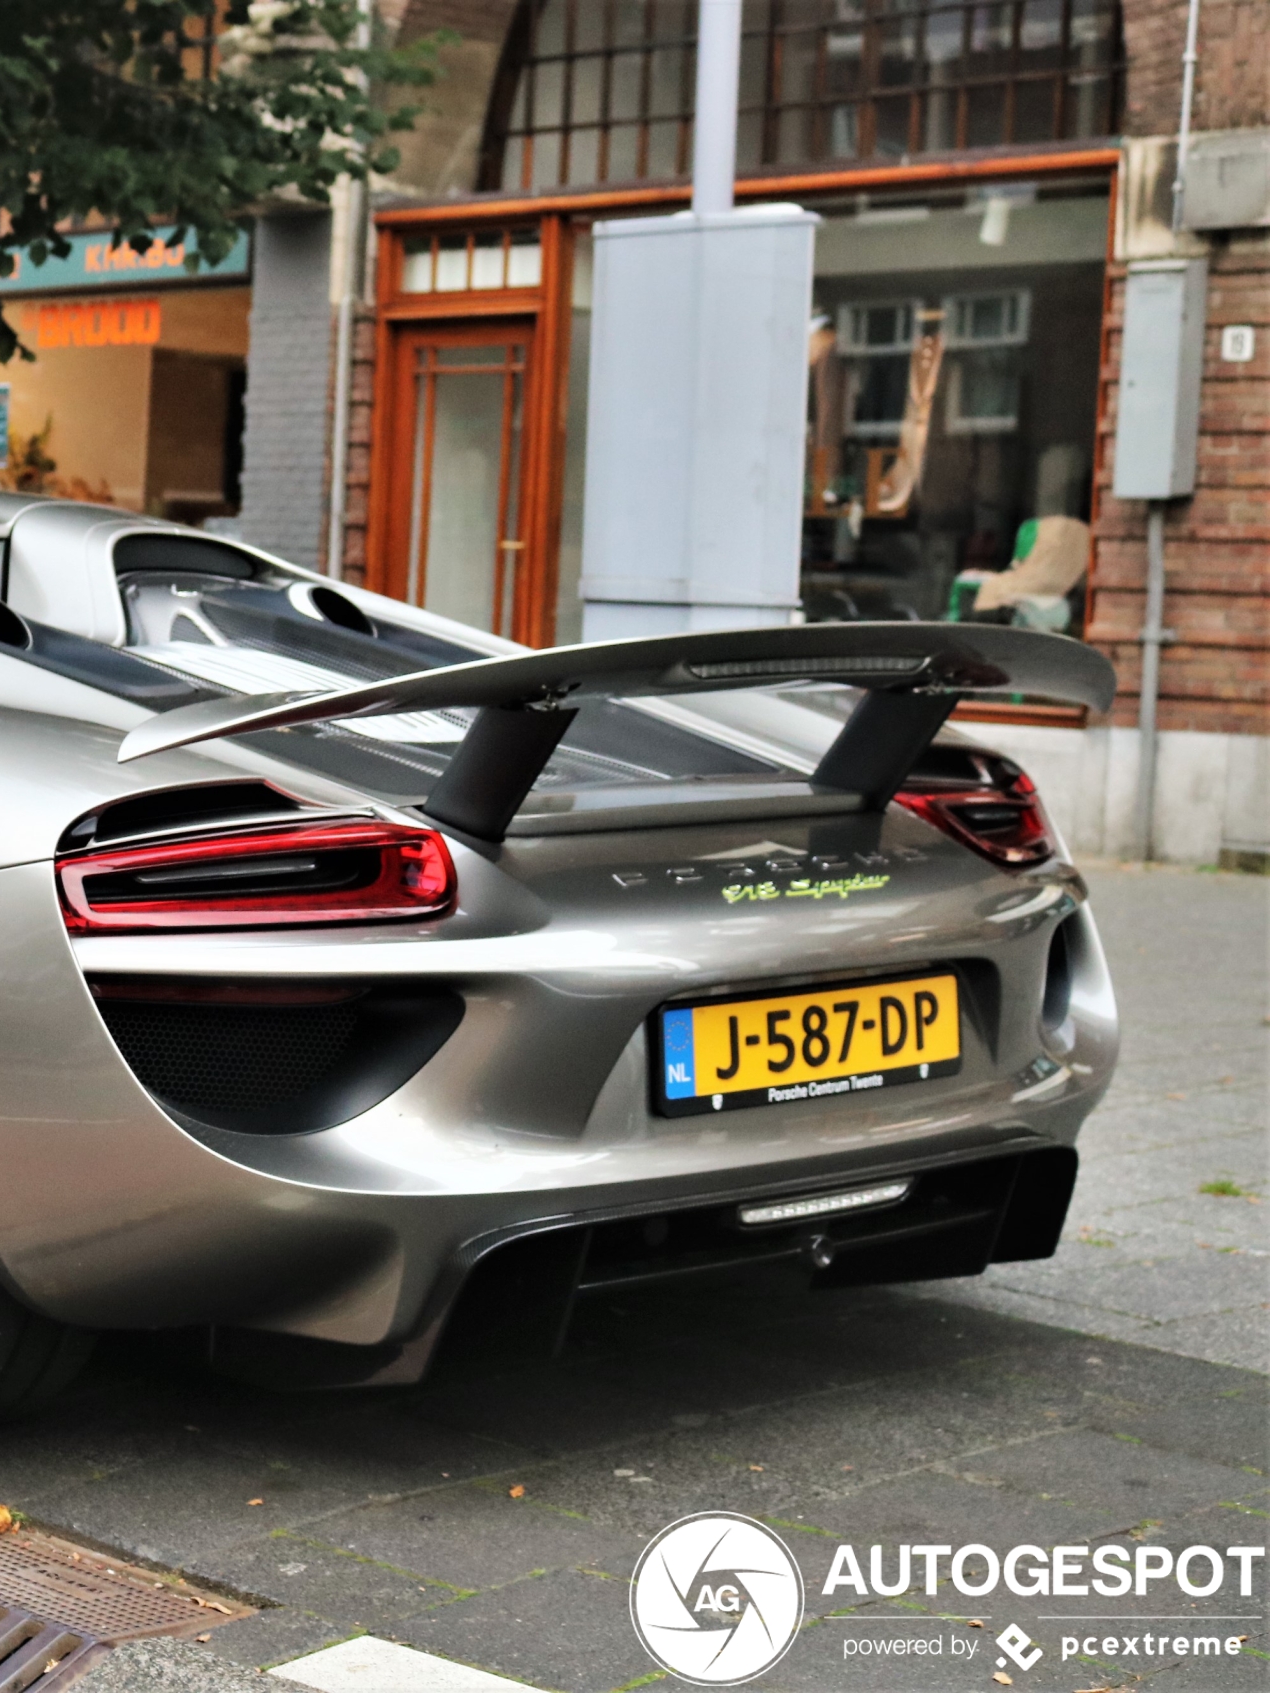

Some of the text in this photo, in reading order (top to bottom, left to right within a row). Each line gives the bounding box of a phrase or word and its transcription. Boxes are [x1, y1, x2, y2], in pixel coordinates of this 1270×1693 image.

[37, 299, 161, 348] BROOD
[716, 990, 939, 1081] J-587-DP
[668, 1063, 691, 1084] NL
[768, 1074, 883, 1103] Porsche Centrum Twente
